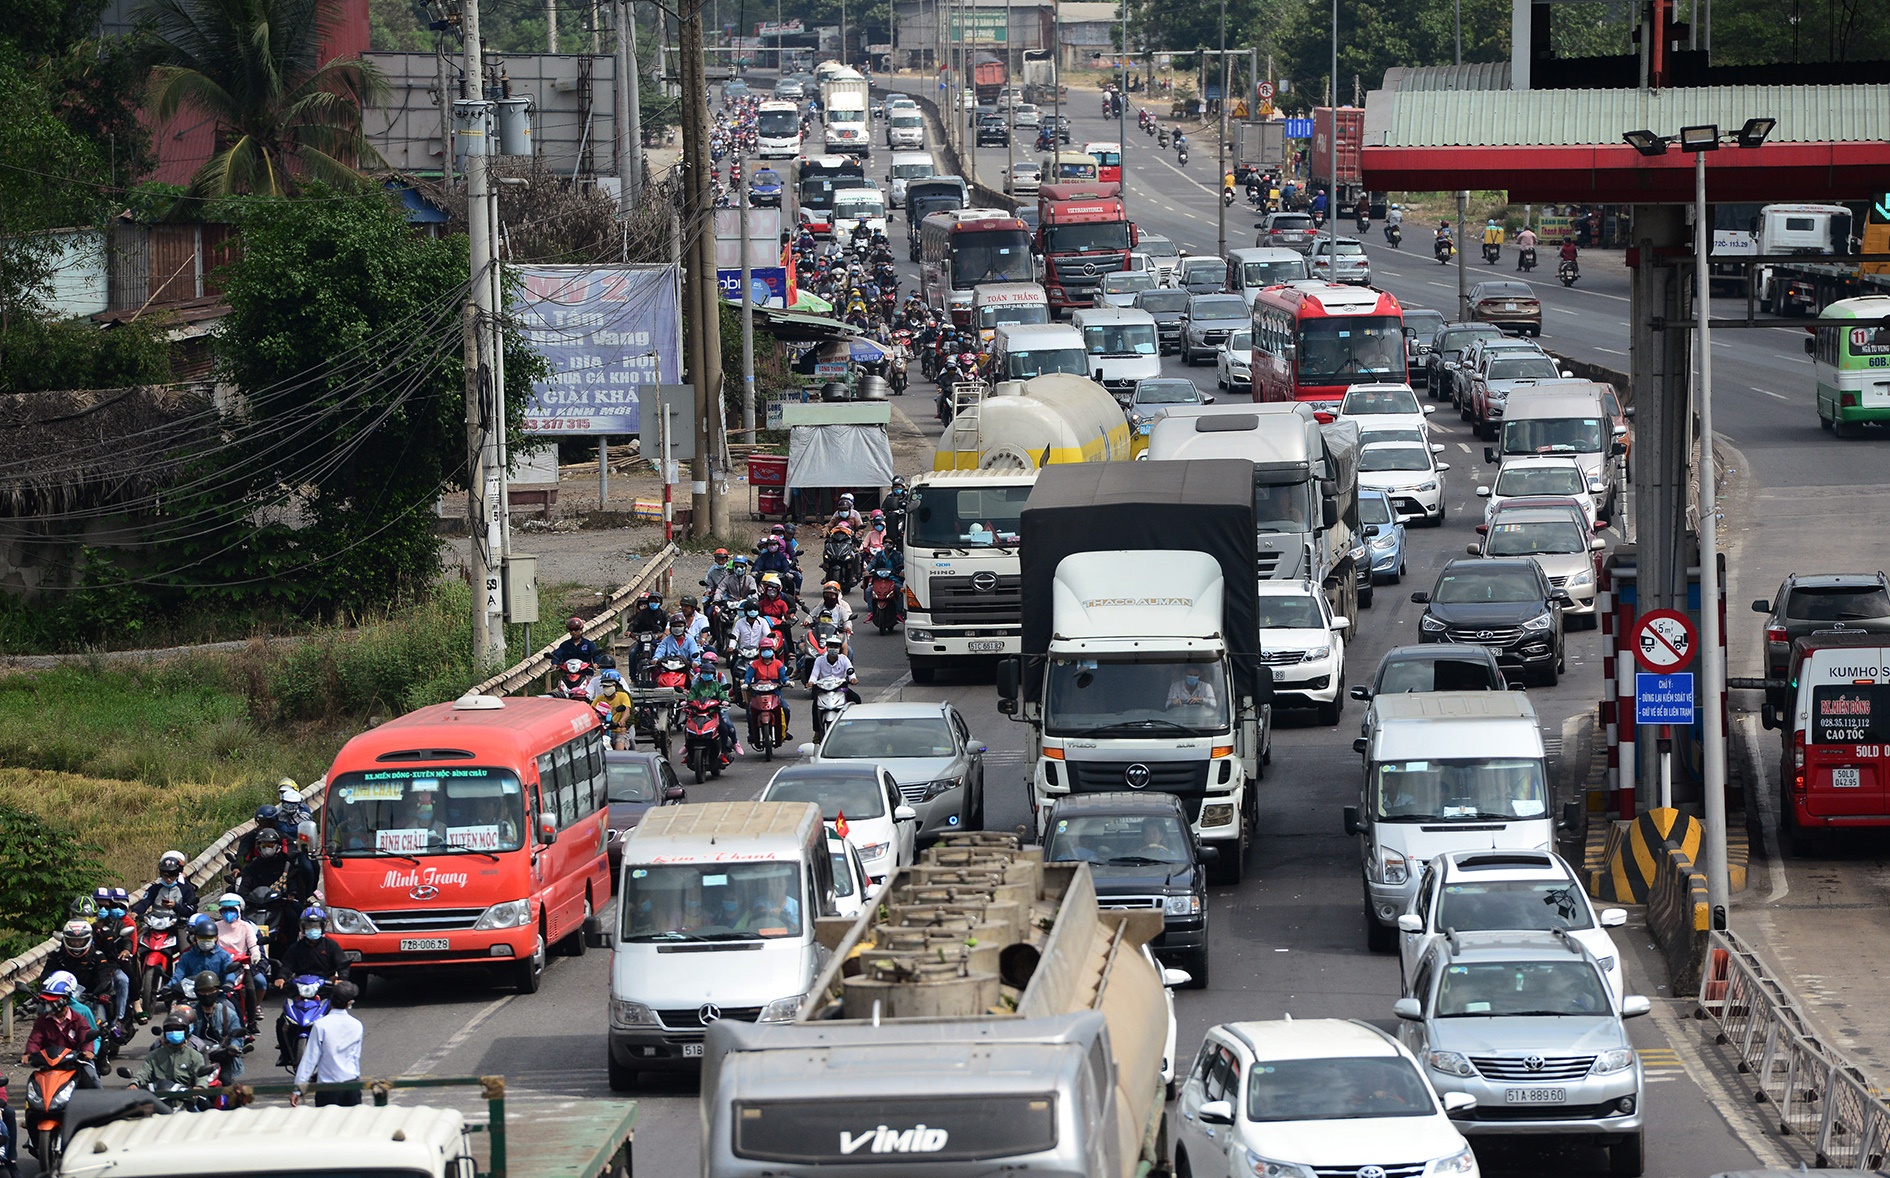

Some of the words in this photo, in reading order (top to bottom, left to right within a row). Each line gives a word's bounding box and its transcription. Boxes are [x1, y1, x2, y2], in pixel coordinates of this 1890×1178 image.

[1853, 331, 1865, 343] 11
[1869, 357, 1890, 367] 60B.
[594, 386, 639, 404] KHÁ
[567, 418, 590, 429] 315
[1082, 598, 1136, 608] THACO
[1136, 597, 1193, 607] AUMAN
[1829, 666, 1878, 678] KUMHO
[1826, 729, 1845, 740] CAO
[1846, 725, 1865, 740] TỐC
[1855, 745, 1879, 757] 50LD
[380, 832, 399, 852] BÌNH
[380, 868, 419, 889] Minh
[422, 867, 468, 888] Trang
[685, 1045, 703, 1056] 51B
